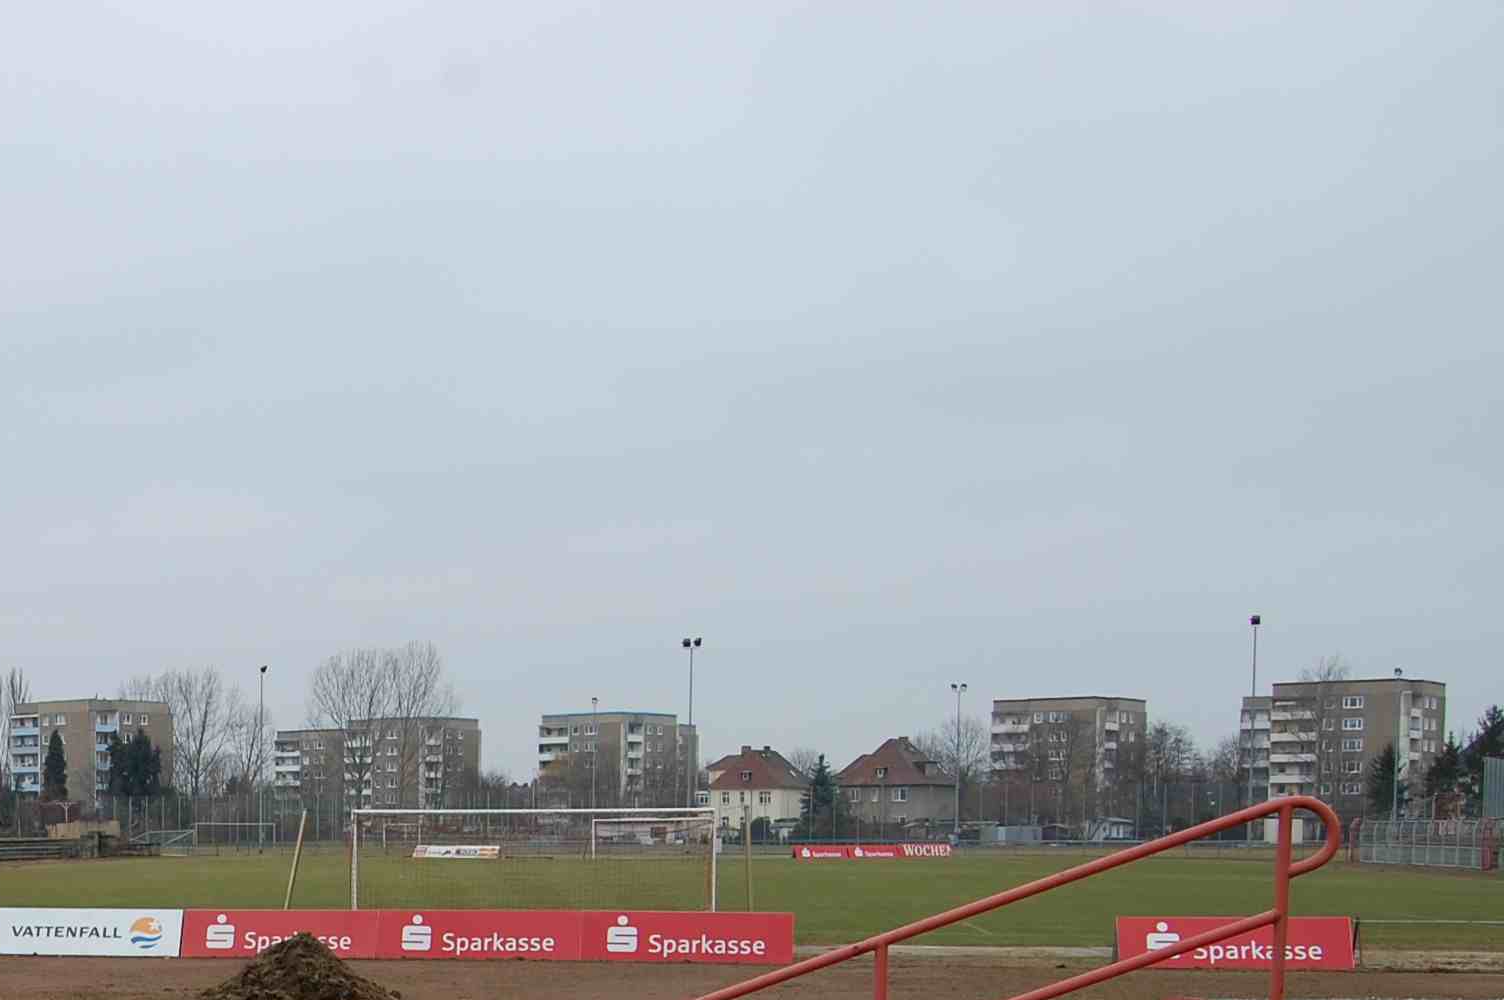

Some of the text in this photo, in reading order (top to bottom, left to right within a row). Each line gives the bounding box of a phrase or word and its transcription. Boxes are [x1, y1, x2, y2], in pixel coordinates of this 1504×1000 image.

[11, 924, 123, 940] VATTENFALL
[243, 931, 352, 954] Spasse
[441, 932, 555, 956] Sparkasse
[648, 934, 765, 958] Sparkasse
